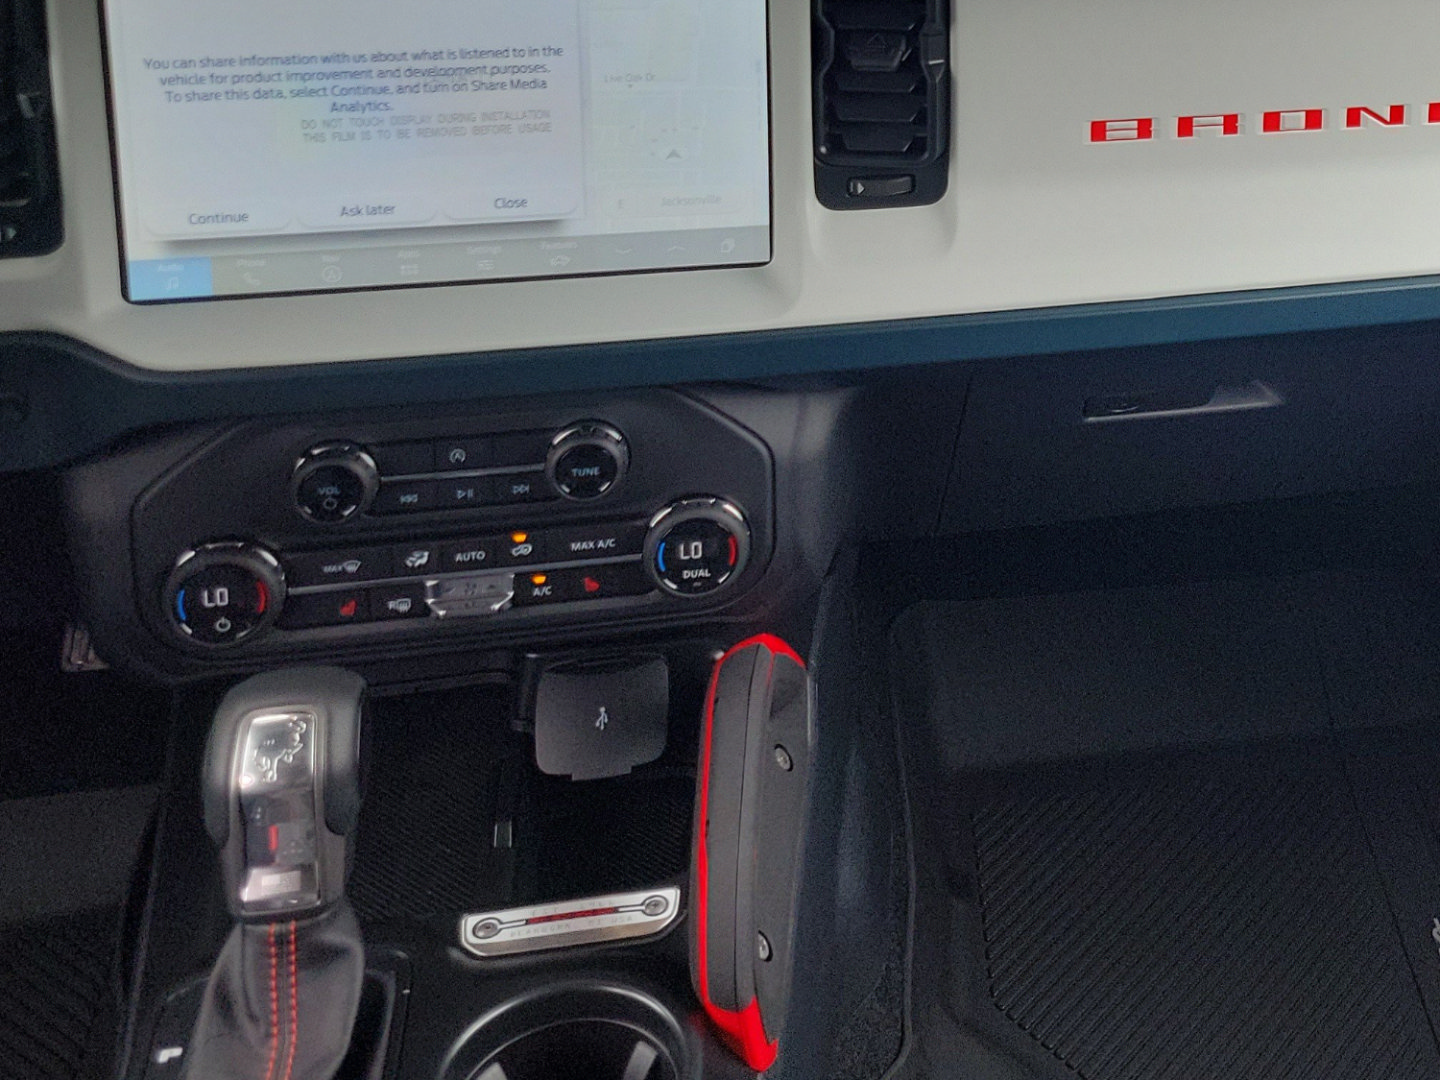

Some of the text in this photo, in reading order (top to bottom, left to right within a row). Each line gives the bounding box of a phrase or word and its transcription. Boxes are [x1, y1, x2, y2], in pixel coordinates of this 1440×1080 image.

[144, 45, 564, 70] You can share information with us about what is listened to in the
[159, 62, 551, 86] vehicle for product improvement and development purposes.
[164, 90, 182, 102] To
[184, 89, 222, 102] share
[225, 88, 250, 101] this
[289, 86, 328, 98] select
[396, 82, 421, 94] and
[423, 81, 449, 93] turn
[452, 82, 468, 92] on
[471, 79, 507, 92] Share
[509, 78, 547, 90] Media
[330, 99, 394, 114] Analytics.
[493, 197, 528, 210] Close
[340, 204, 396, 217] Ask later
[188, 212, 249, 225] Continue
[571, 466, 600, 477] TUNE
[318, 486, 341, 496] VOL
[571, 538, 616, 552] MAX A/C
[456, 551, 486, 562] AUTO
[683, 568, 711, 579] DUAL
[533, 585, 553, 596] A/C
